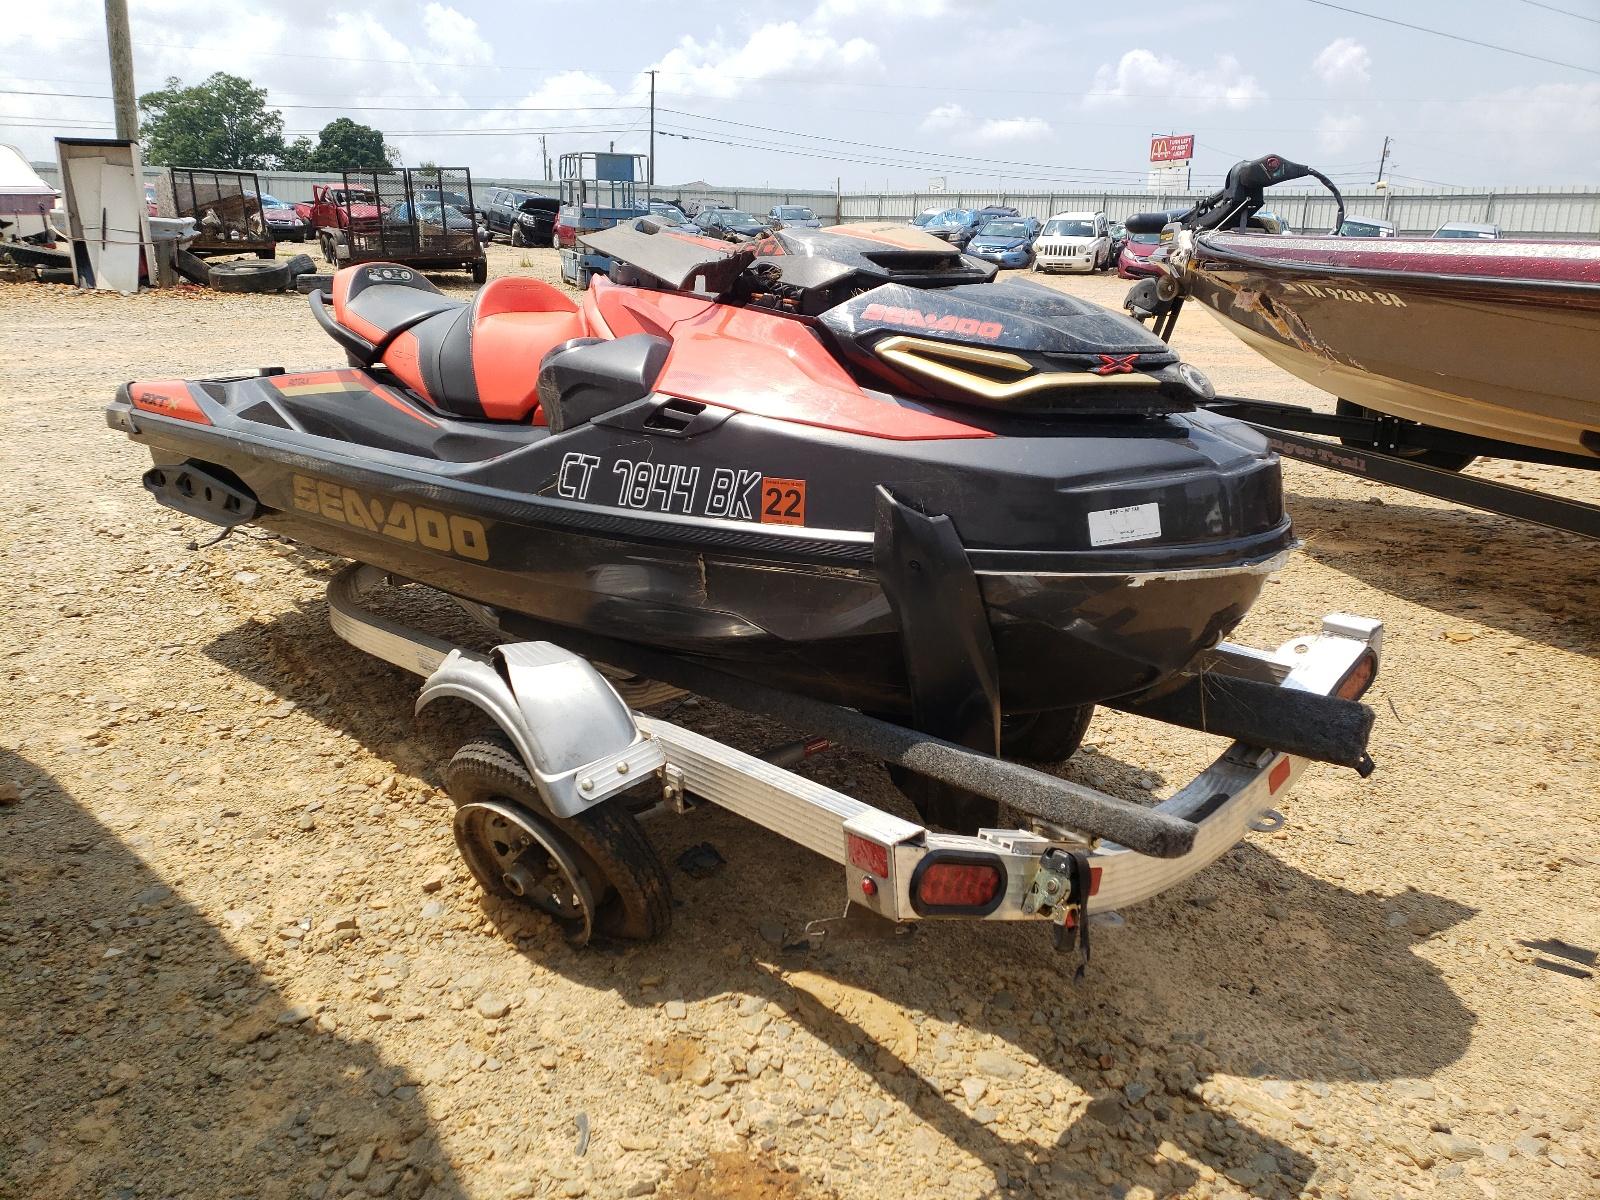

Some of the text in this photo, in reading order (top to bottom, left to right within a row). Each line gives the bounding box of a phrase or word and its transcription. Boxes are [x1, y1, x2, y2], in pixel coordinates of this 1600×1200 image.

[1296, 284, 1408, 308] VA 9284 BA
[1317, 448, 1366, 471] Trail
[558, 452, 762, 520] CT 7844 BK
[765, 487, 802, 518] 22
